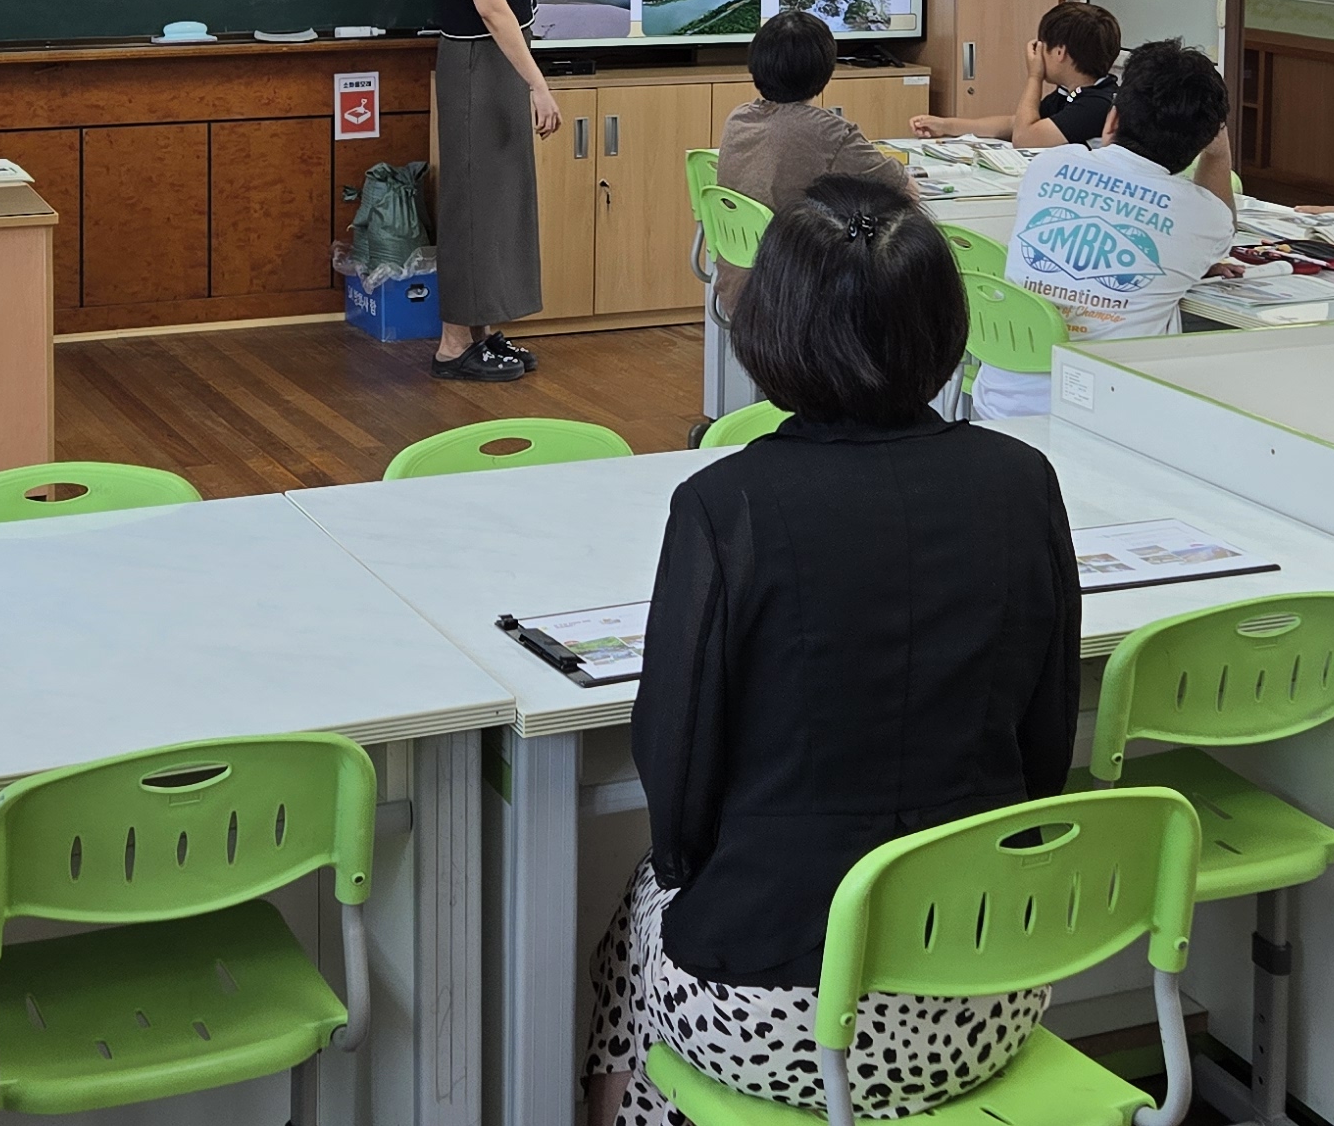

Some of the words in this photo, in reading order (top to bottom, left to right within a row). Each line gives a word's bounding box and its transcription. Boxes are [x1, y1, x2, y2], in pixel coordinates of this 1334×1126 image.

[1038, 182, 1174, 236] SPORTSWEAR
[1055, 164, 1171, 209] AUTHENTIC
[1024, 276, 1129, 309] international
